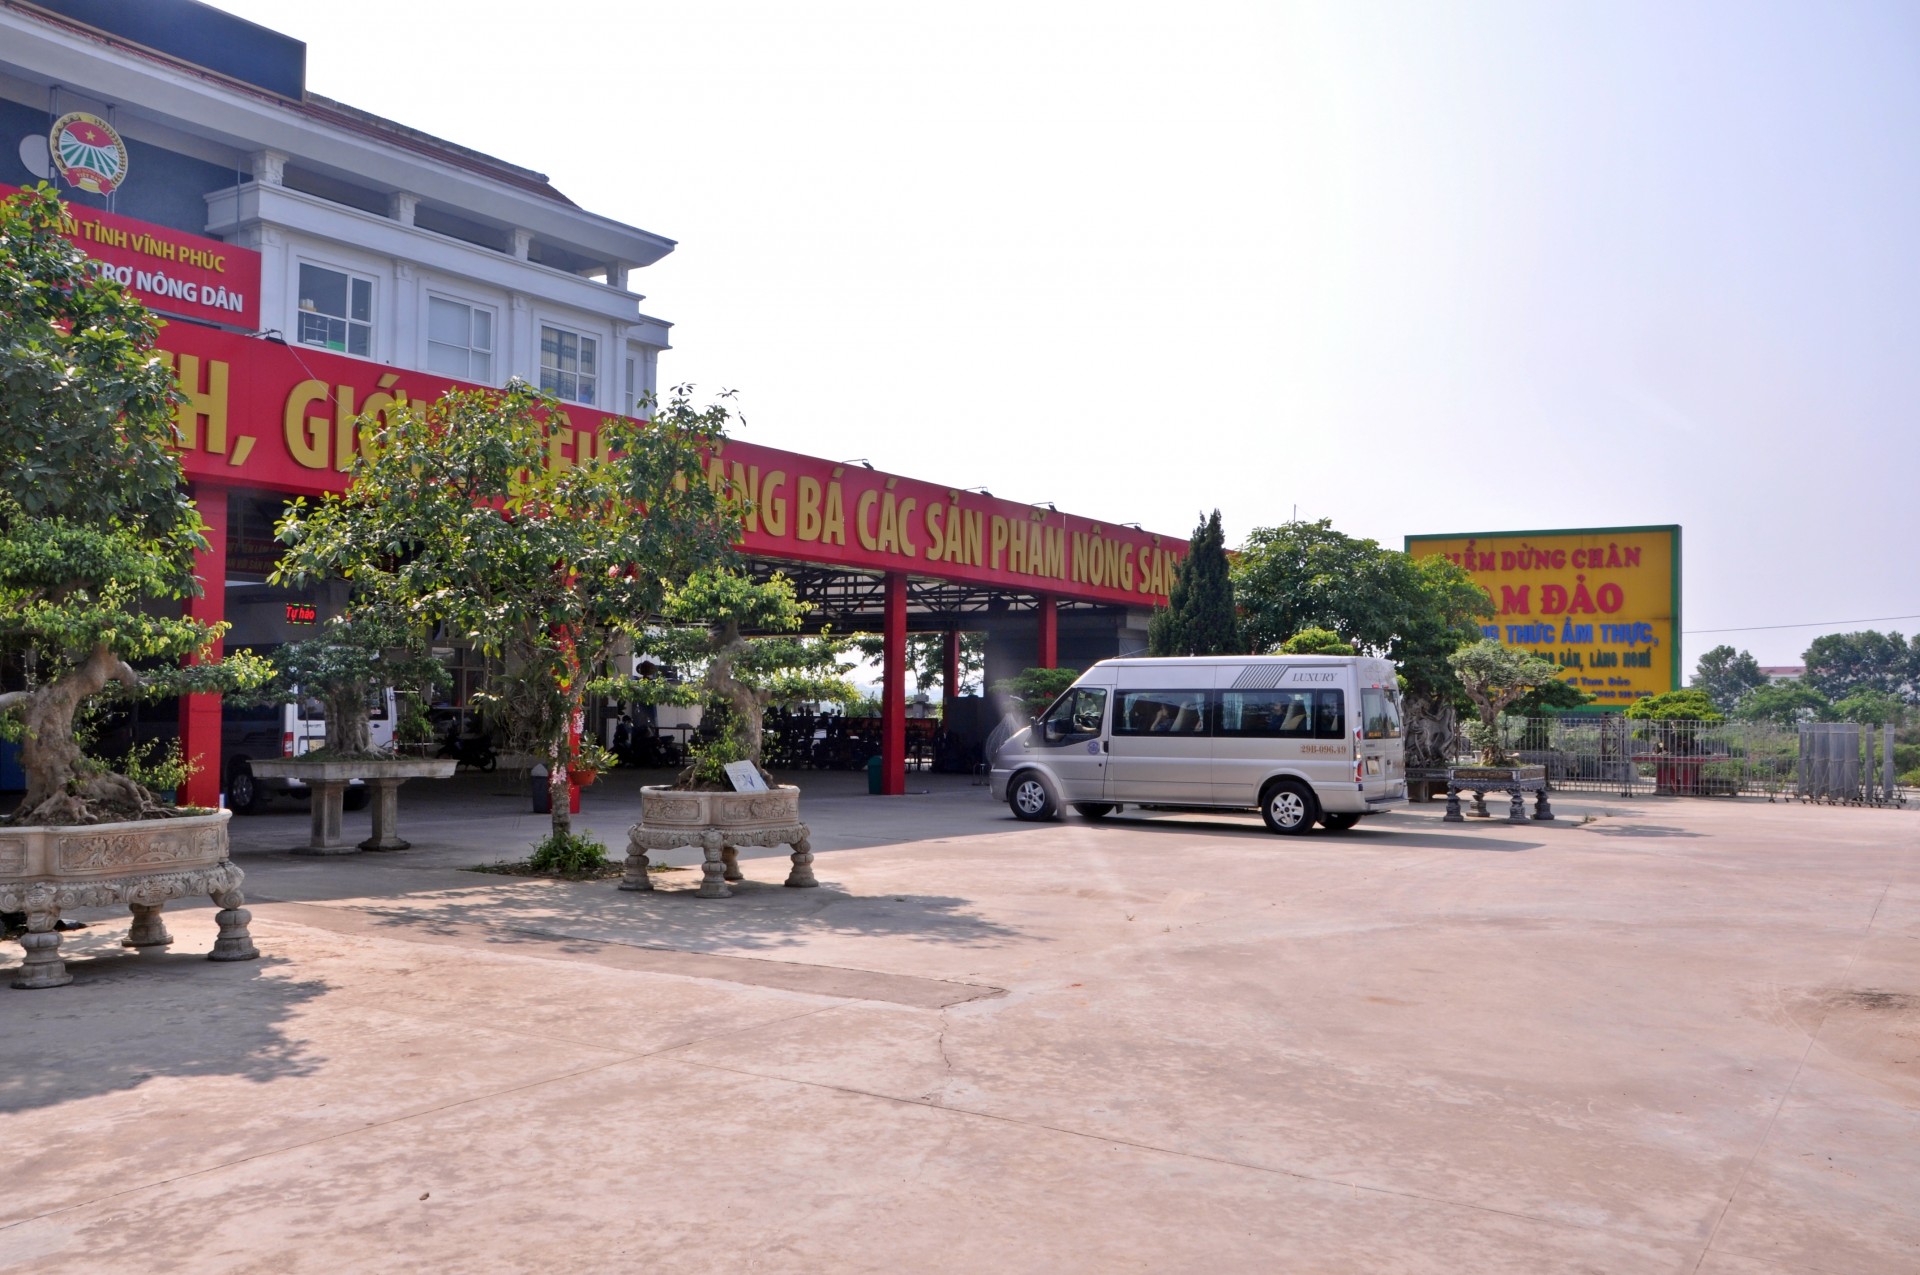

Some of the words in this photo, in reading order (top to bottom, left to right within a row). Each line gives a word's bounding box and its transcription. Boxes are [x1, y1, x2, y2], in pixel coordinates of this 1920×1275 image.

[82, 219, 127, 249] TỈNH
[131, 232, 176, 262] VĨNH
[178, 248, 226, 273] PHÚC
[136, 271, 197, 300] NÔNG
[201, 285, 243, 313] DÂN
[796, 467, 846, 545] BÁ
[856, 477, 916, 557] CÁC
[925, 489, 982, 567] SẢN
[990, 508, 1065, 579] PHẨM
[1071, 525, 1133, 591] NÔNG
[1500, 542, 1566, 571] DỪNG
[1571, 542, 1641, 569] CHÂN
[1540, 574, 1624, 615] ĐẢO
[1292, 672, 1338, 682] LUXURY
